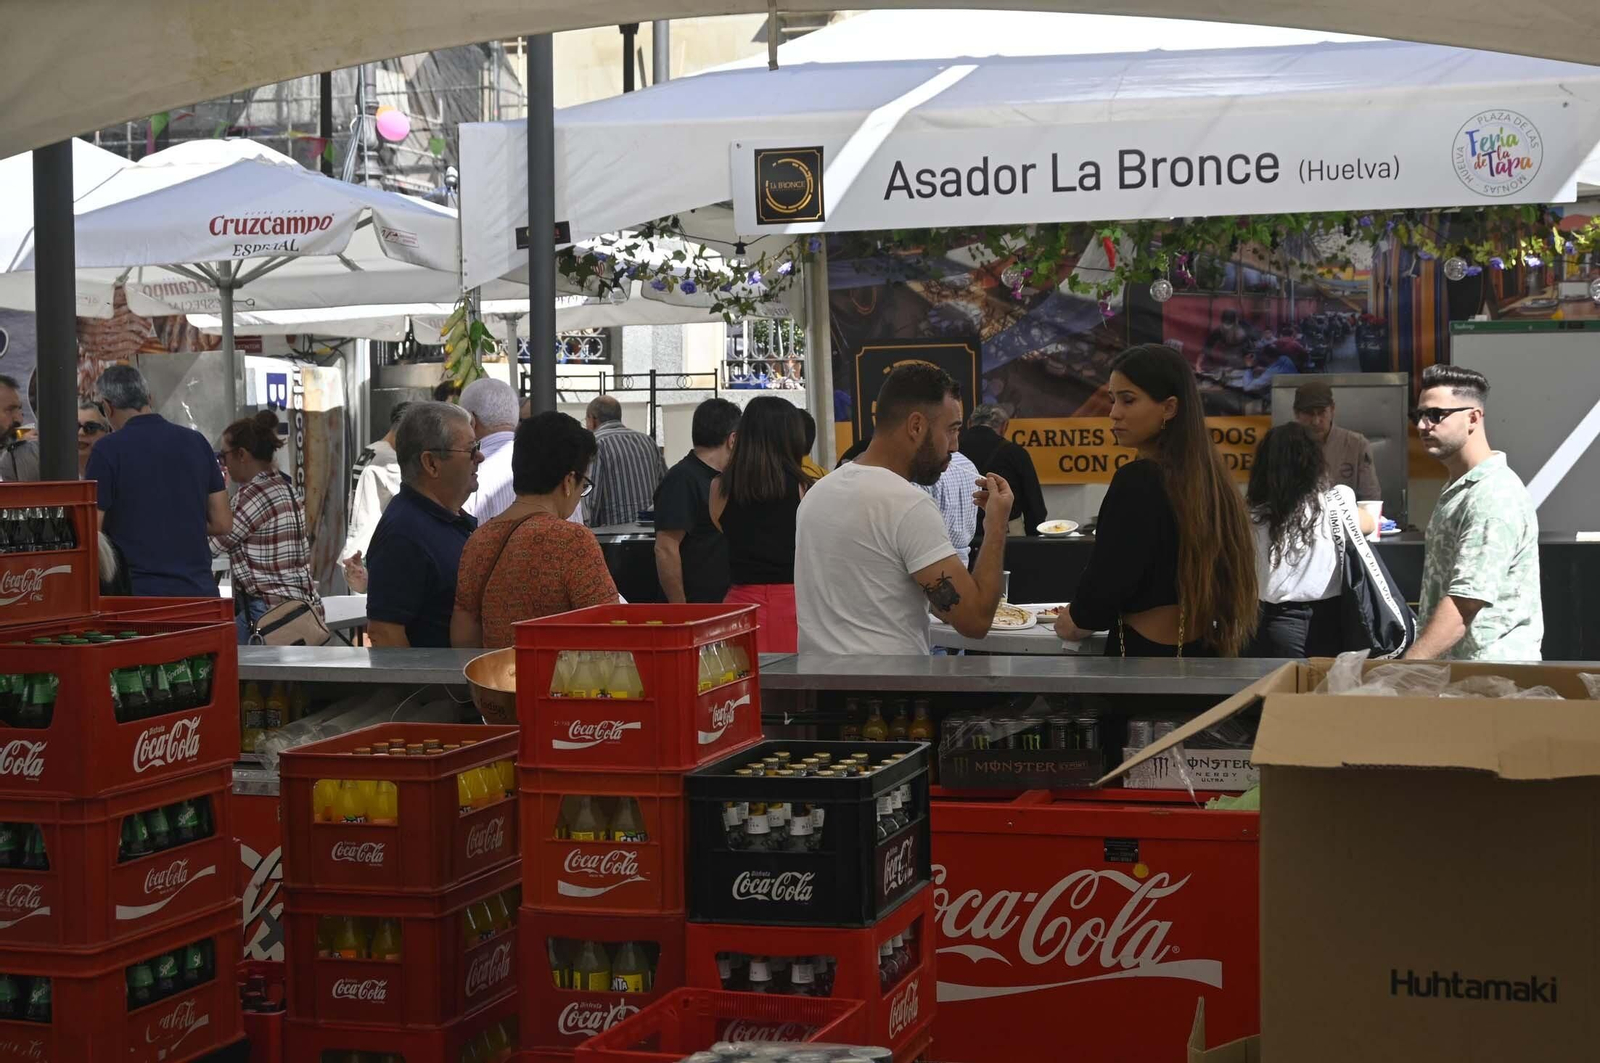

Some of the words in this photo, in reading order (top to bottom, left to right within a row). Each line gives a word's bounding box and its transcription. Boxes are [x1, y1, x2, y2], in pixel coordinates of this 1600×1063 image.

[1476, 112, 1511, 125] PLAZA
[1513, 116, 1528, 130] DE
[1465, 126, 1519, 157] Feria
[1525, 129, 1540, 149] LAS
[1456, 145, 1474, 184] HUELVA
[1473, 152, 1487, 170] de
[1482, 150, 1533, 177] Tapa
[1496, 145, 1510, 161] la
[884, 156, 1037, 200] Asador
[1051, 152, 1102, 193] La
[1118, 148, 1280, 190] Bronce
[1299, 154, 1401, 185] (Huelva)
[1483, 174, 1527, 194] MONJAS
[209, 213, 333, 236] Cruzcampo
[1012, 429, 1104, 447] CARNES
[1059, 455, 1109, 473] CON
[2, 568, 44, 594] Coca-Cola
[568, 719, 625, 740] Coca-Cola
[133, 715, 202, 773] Coca-Cola
[975, 760, 1057, 774] MONSTER
[1186, 757, 1254, 770] ONSTER
[466, 813, 506, 859] Coca-Cola
[331, 841, 387, 862] Coca-Cola
[563, 848, 640, 875] Coca-Cola
[144, 858, 190, 895] Coca-Cola
[732, 871, 816, 902] Coca-Cola
[465, 940, 512, 997] Coca-Cola
[332, 978, 388, 1001] Coca-Cola
[1390, 968, 1558, 1004] Huhtamaki
